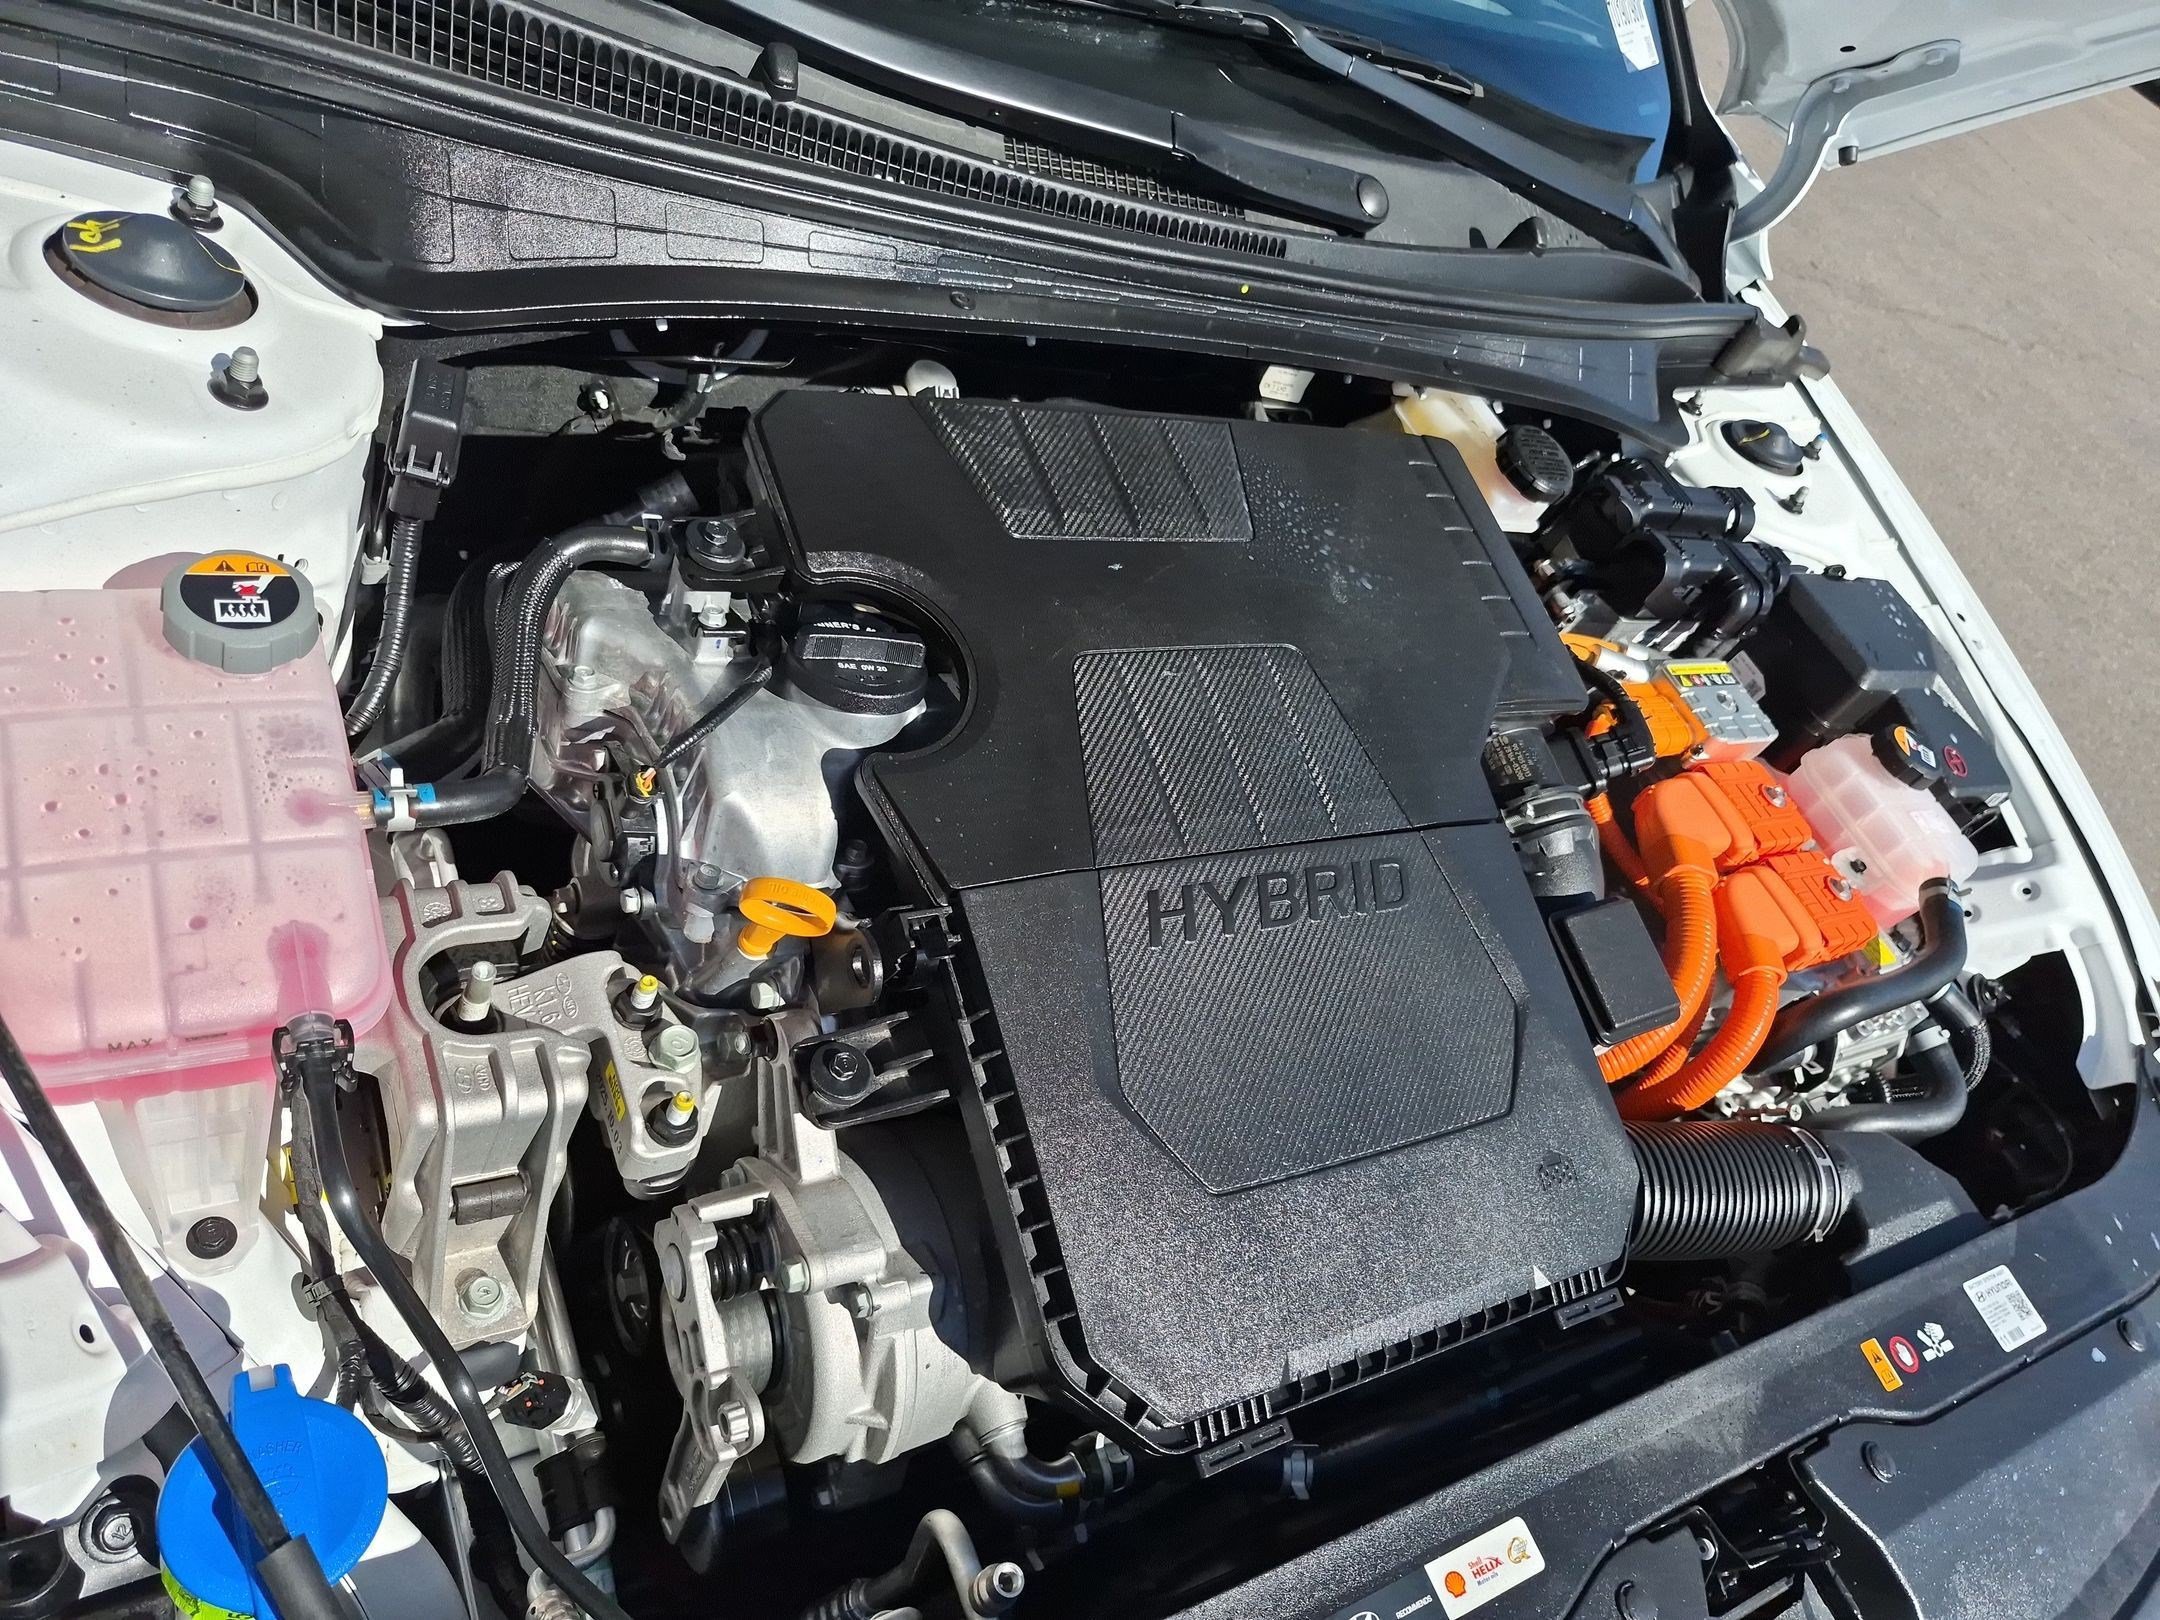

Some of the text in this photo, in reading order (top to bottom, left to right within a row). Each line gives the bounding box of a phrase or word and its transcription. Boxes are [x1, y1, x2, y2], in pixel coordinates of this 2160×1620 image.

[837, 662, 888, 673] SAE 0W 20
[1147, 857, 1411, 949] HYBRID
[506, 983, 537, 1016] HEV
[107, 1038, 152, 1053] MAX
[110, 1523, 133, 1541] 12
[1467, 1556, 1483, 1570] Shell
[1471, 1557, 1503, 1580] HELIX
[1395, 1594, 1433, 1620] RECOMMENDS
